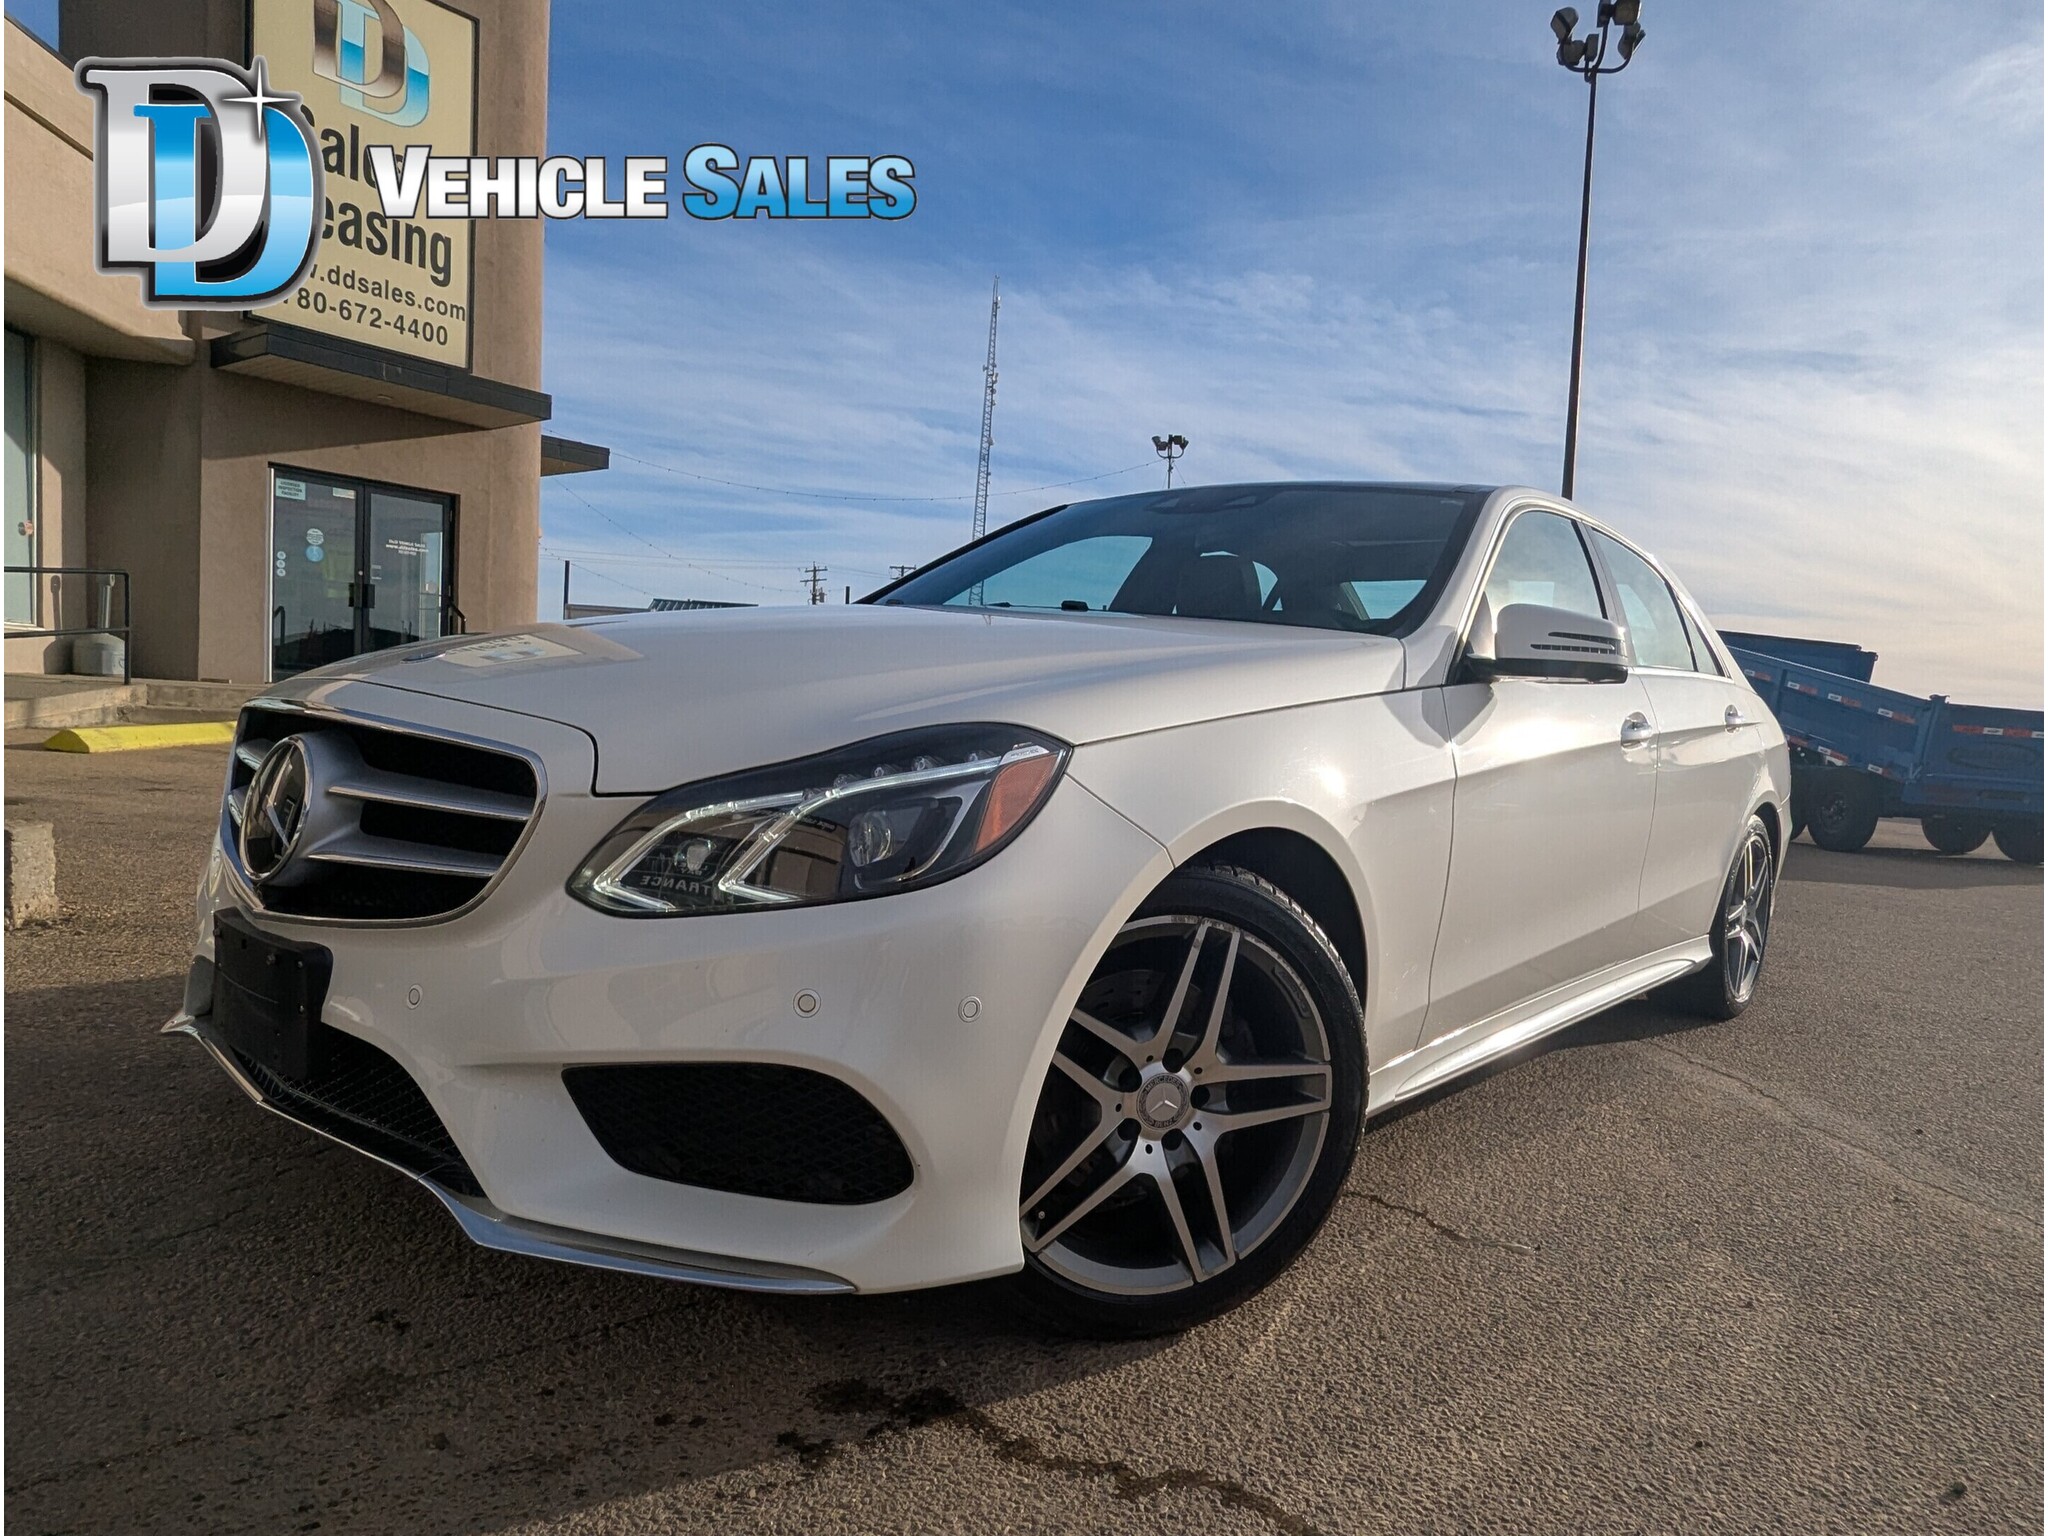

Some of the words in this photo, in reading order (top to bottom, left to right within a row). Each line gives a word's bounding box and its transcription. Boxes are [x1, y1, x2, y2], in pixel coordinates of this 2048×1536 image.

[322, 195, 452, 288] easing
[297, 287, 449, 346] 80-672-4400
[1146, 1075, 1181, 1091] MERCEDES
